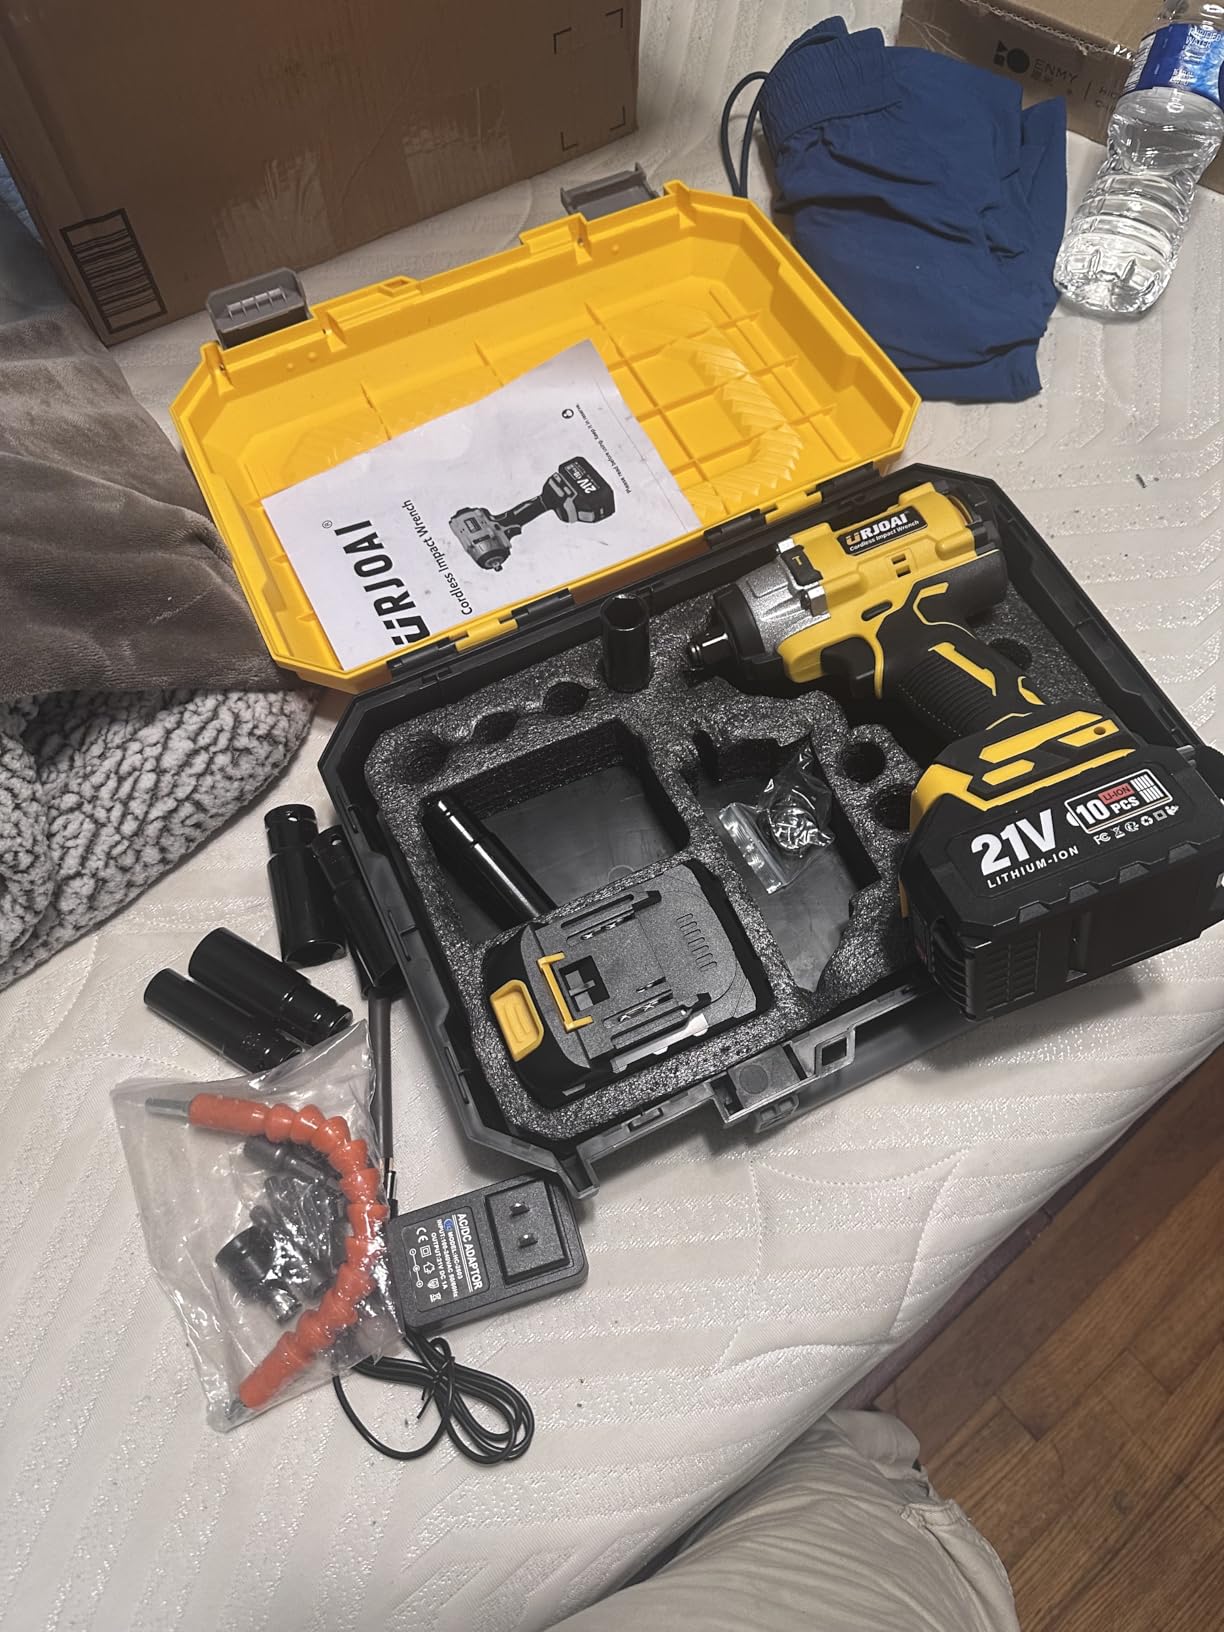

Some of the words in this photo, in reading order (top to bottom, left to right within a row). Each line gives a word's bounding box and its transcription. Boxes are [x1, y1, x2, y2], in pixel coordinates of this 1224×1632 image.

[1034, 58, 1079, 83] ENMY
[401, 499, 430, 536] Wrench
[425, 533, 451, 573] Impact
[849, 537, 876, 552] Cordless
[876, 529, 897, 542] Impact
[897, 520, 920, 533] Wrench
[445, 570, 474, 616] Cordless
[1103, 784, 1131, 801] LI-ION
[1110, 796, 1141, 814] PCS
[1075, 799, 1109, 825] 10
[970, 808, 1057, 877] 21V
[986, 845, 1080, 889] LITHIUM-ION
[457, 1213, 472, 1242] AC/DC
[464, 1243, 483, 1290] ADAPTOR
